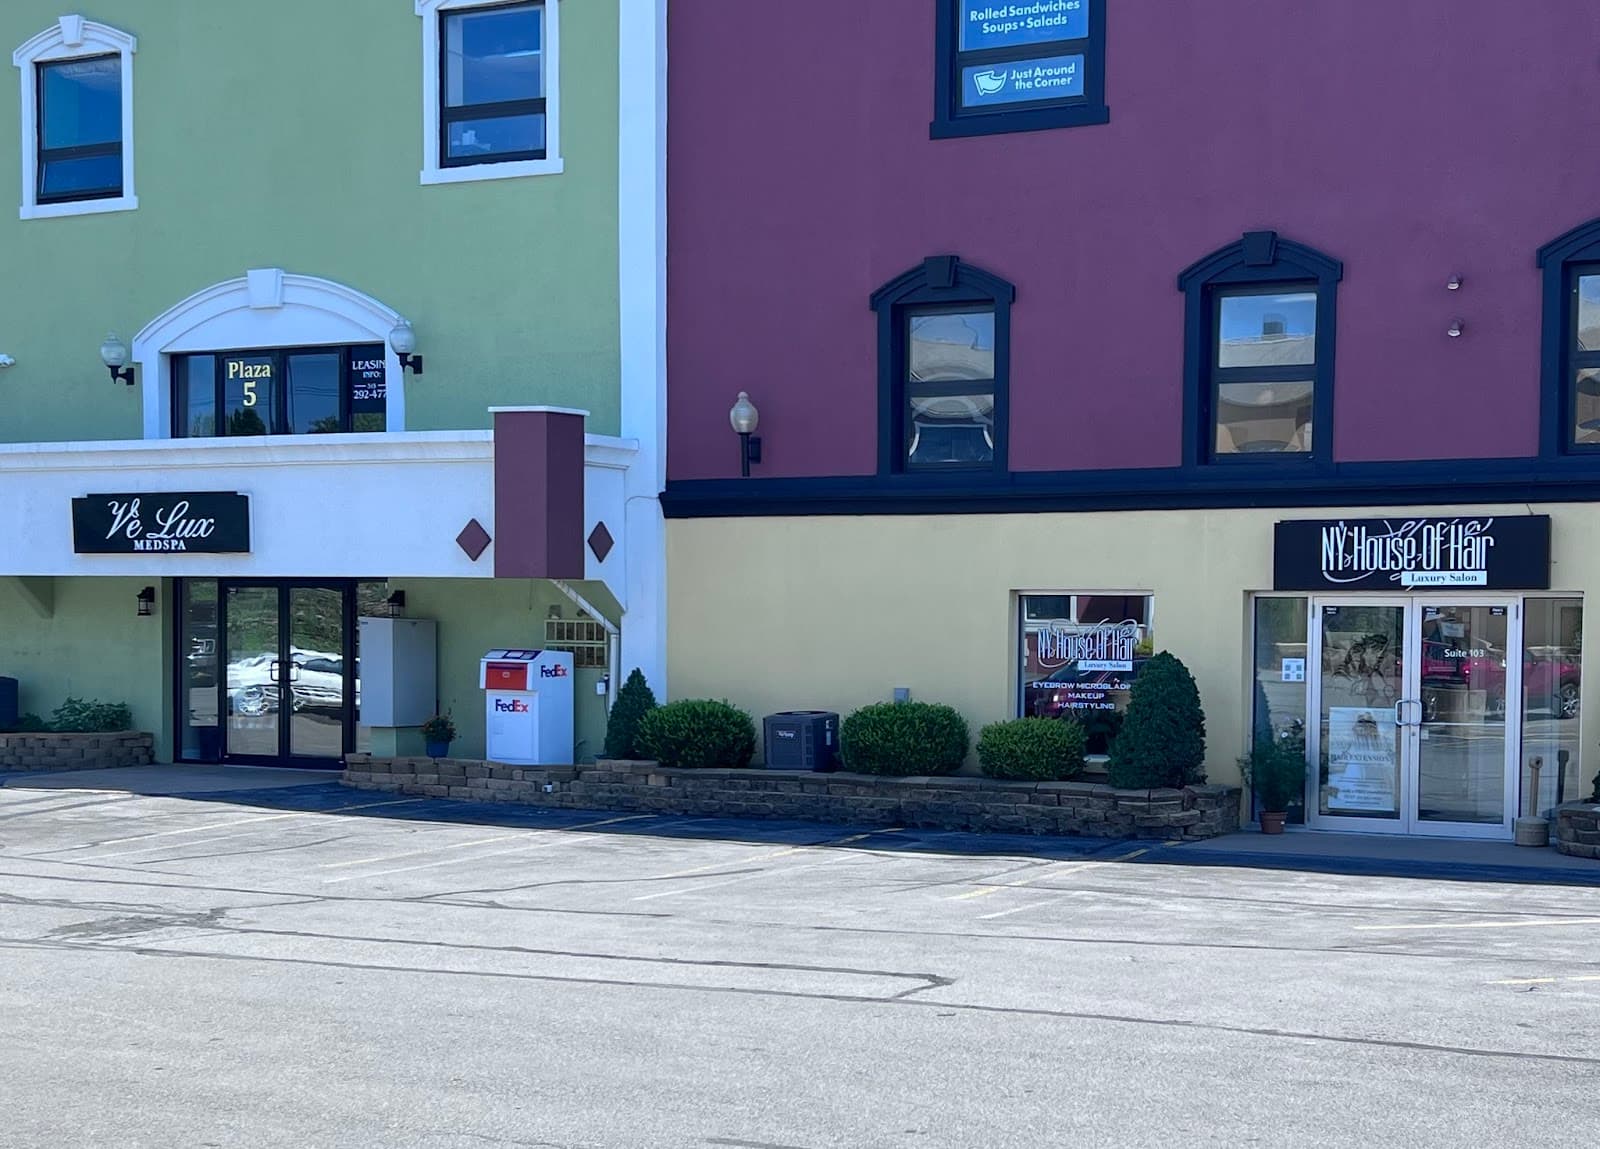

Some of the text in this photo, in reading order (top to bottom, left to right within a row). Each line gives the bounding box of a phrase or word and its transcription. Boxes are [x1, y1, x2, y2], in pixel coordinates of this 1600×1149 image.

[970, 0, 1080, 21] Rolled Sandwiches
[982, 13, 1067, 34] Soups Salads
[1010, 62, 1075, 80] Just Around
[1015, 77, 1072, 90] the Corner
[228, 360, 271, 379] Plaza
[352, 360, 386, 370] LEASIN
[243, 380, 257, 406] 5
[353, 389, 387, 399] 292-477
[146, 501, 215, 538] Lux
[134, 539, 186, 550] MEDSPA
[1322, 521, 1495, 571] NY House Of Hair
[1411, 573, 1478, 584] Luxury Salon
[1037, 629, 1052, 659] NY
[1056, 629, 1093, 660] House
[1111, 629, 1137, 660] Hair
[1444, 648, 1484, 658] Suite 103
[540, 664, 567, 678] FedEx
[1032, 681, 1075, 689] EYEBROW
[1067, 692, 1105, 700] MAKEUP
[495, 699, 529, 713] FedEx
[1057, 701, 1115, 710] HAIRSTYLING
